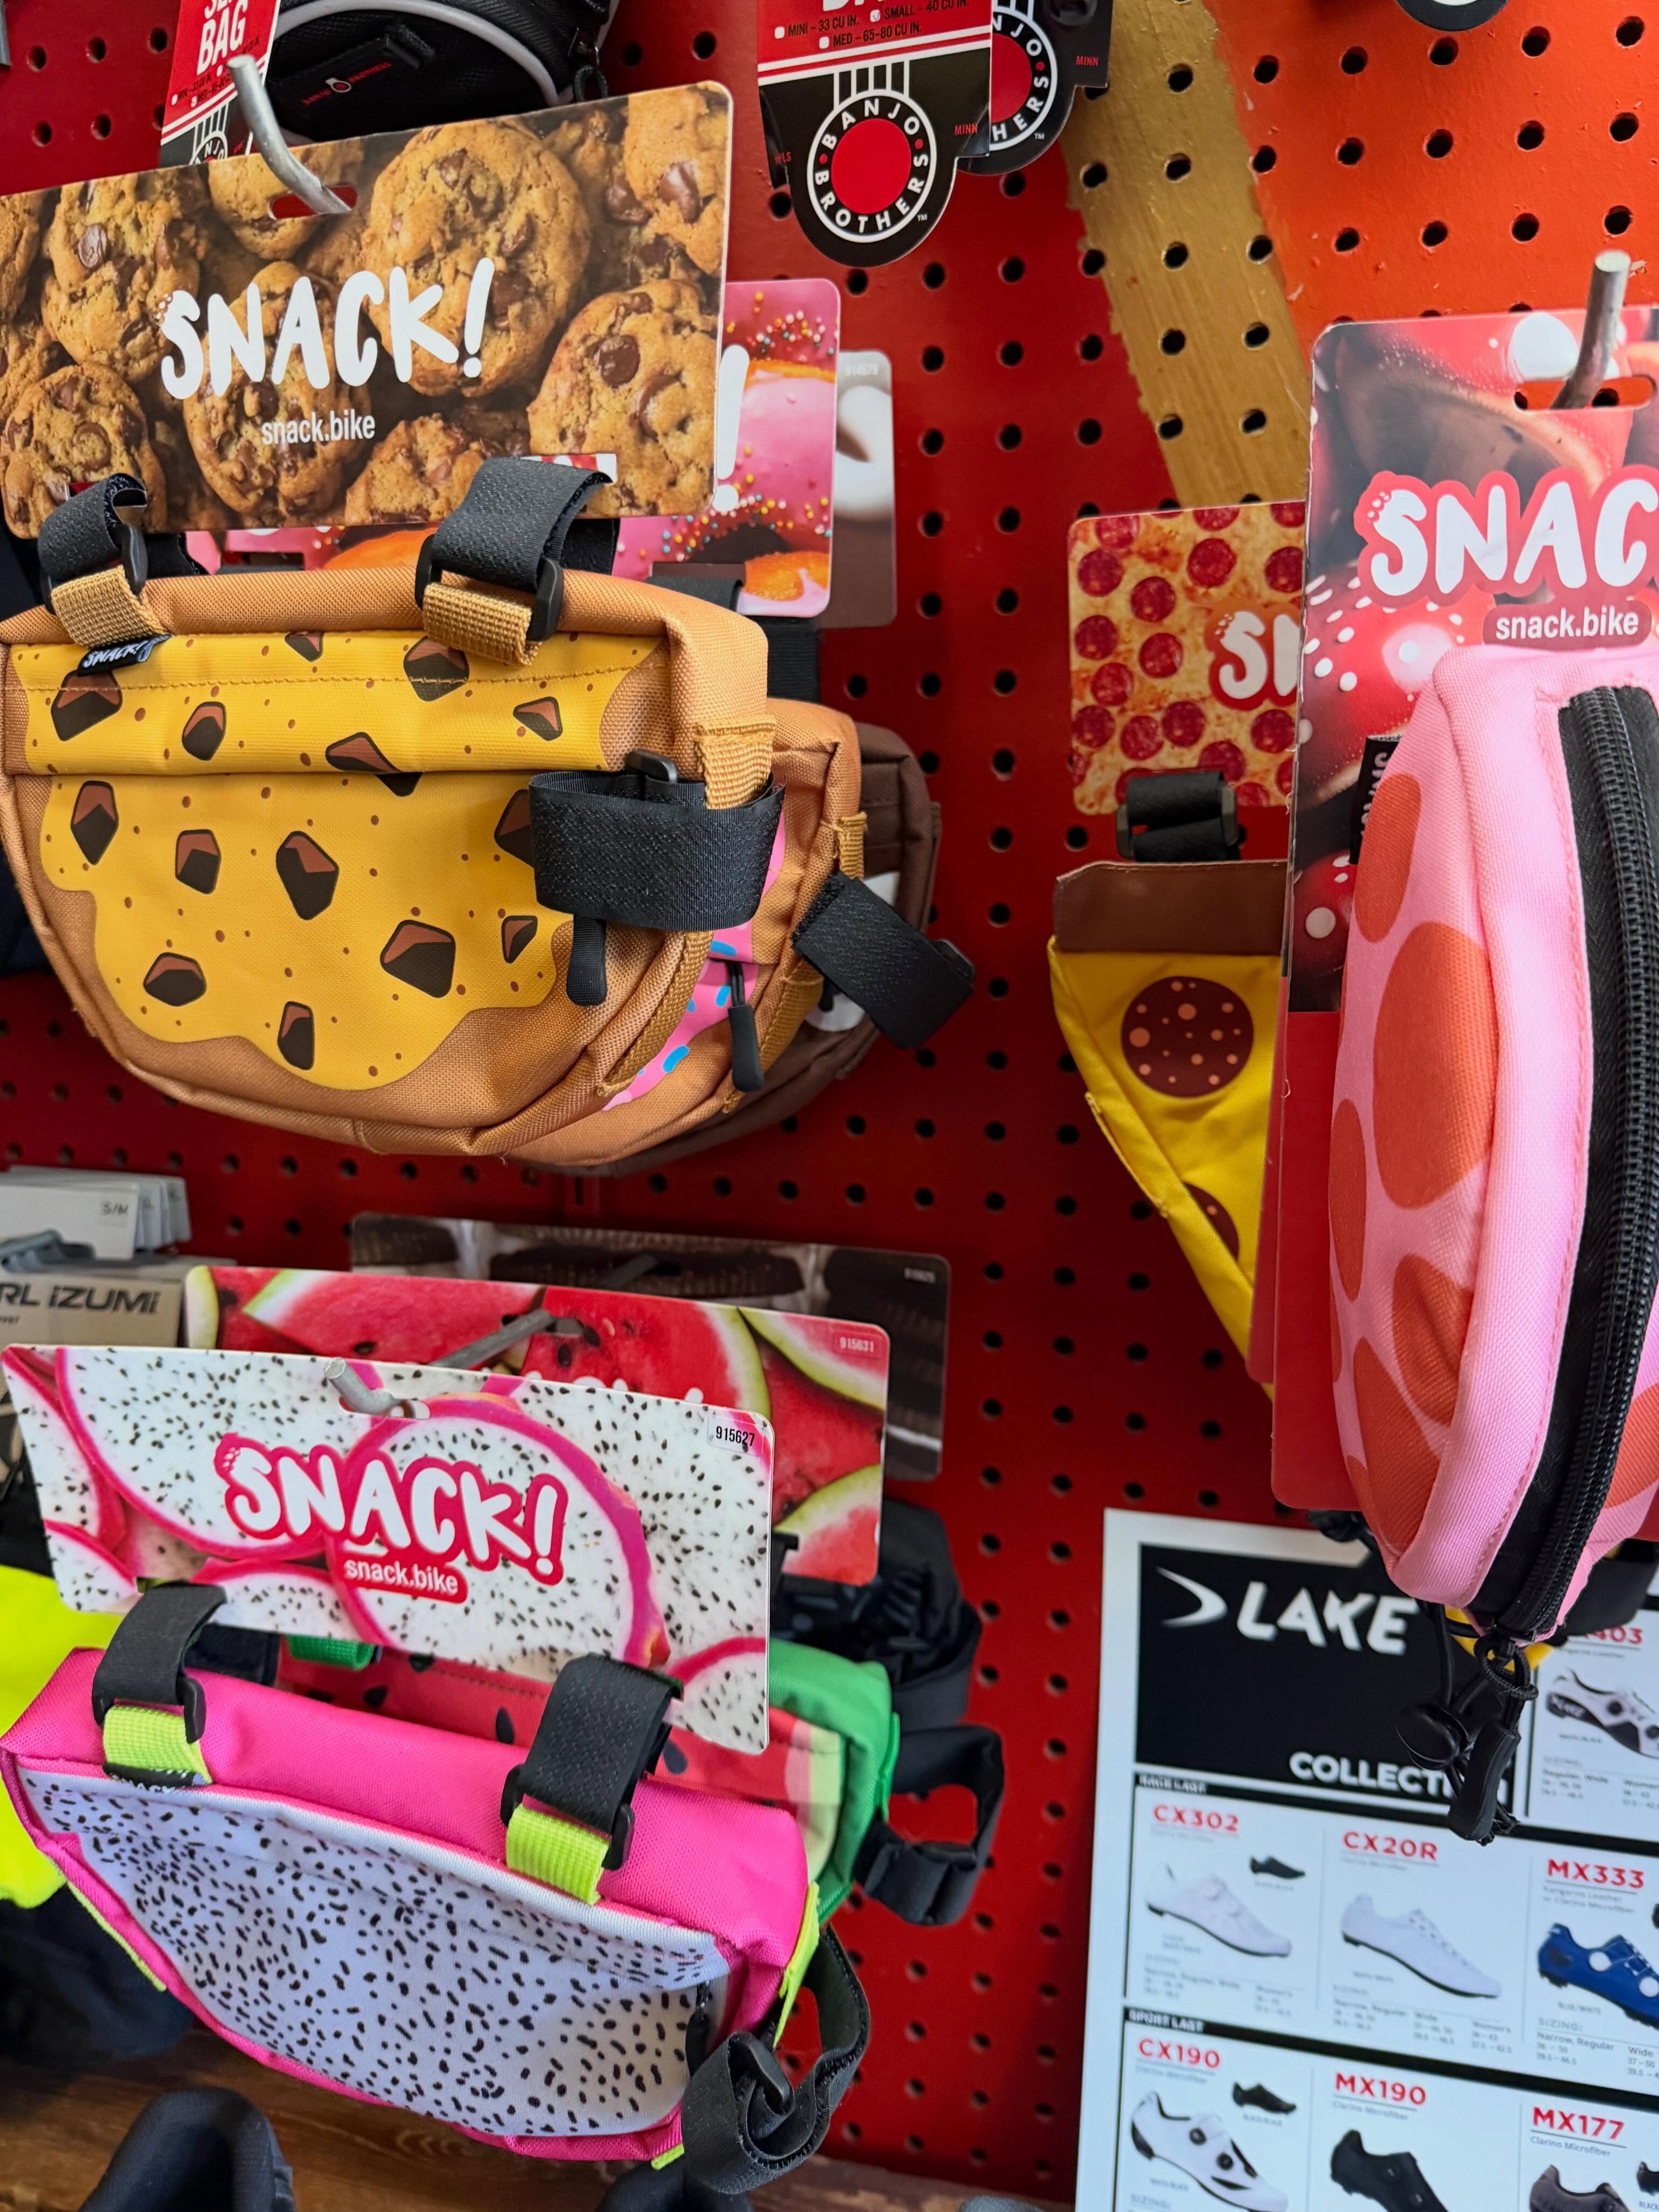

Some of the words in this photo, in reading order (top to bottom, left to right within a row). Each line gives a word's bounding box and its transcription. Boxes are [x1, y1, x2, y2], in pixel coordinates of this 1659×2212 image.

[788, 22, 807, 37] MINI
[818, 19, 831, 31] 33
[832, 17, 845, 29] CU
[847, 15, 859, 26] IN.
[885, 7, 914, 20] SMALL
[196, 0, 248, 76] BAG
[833, 33, 852, 46] MED
[894, 24, 908, 36] CU
[1075, 56, 1098, 66] MINN
[821, 98, 921, 151] BANJO
[954, 123, 978, 135] MINN
[815, 153, 929, 234] BROTHERS
[156, 257, 495, 400] SNACK!
[261, 409, 376, 446] snack.bike
[1495, 606, 1639, 642] snack.bike
[716, 1426, 755, 1446] 915627
[222, 1446, 557, 1575] SNACK!
[345, 1557, 459, 1598] snack.bike
[1237, 1581, 1420, 1656] LAKE
[1154, 1804, 1238, 1832] CX302
[1342, 1831, 1438, 1862] CX20R
[1548, 1859, 1644, 1889] MX333
[1139, 2038, 1220, 2068] CX190
[1576, 2038, 1615, 2051] Regular
[1629, 2047, 1654, 2058] Wide
[1336, 2072, 1426, 2105] MX190
[1533, 2106, 1625, 2140] MX177
[1530, 2136, 1562, 2149] Clarino
[1565, 2142, 1611, 2157] Microfiber
